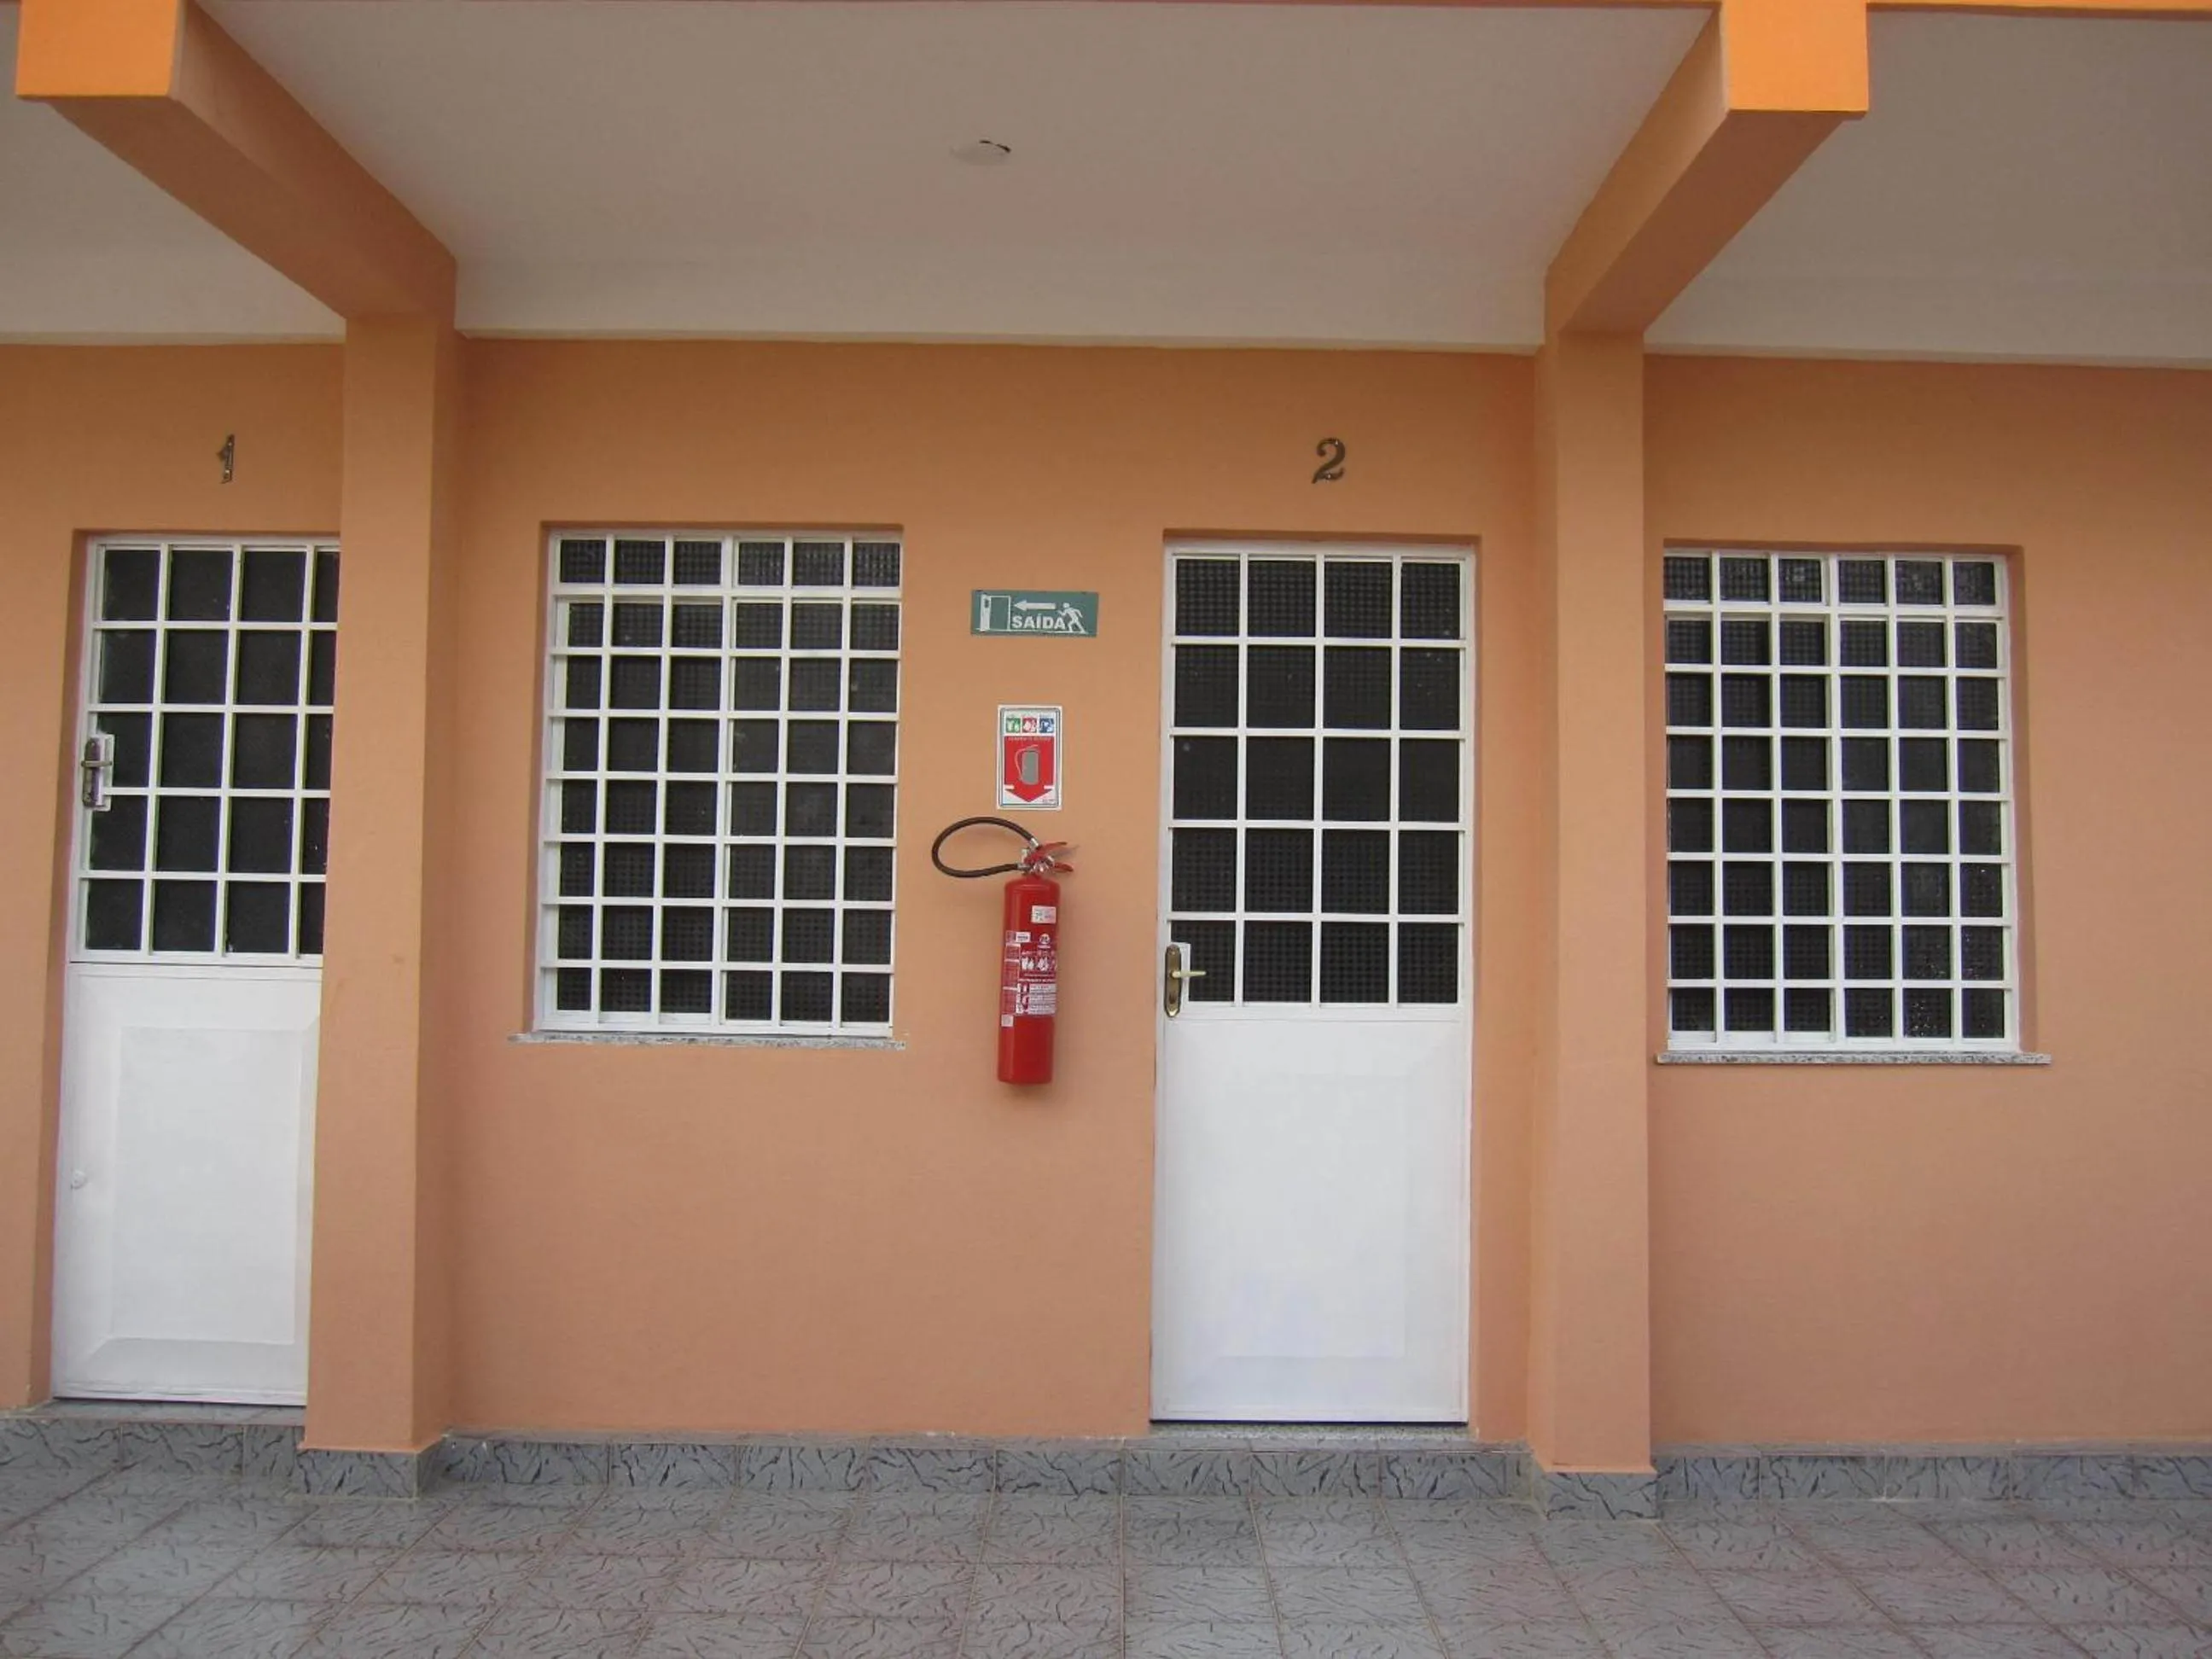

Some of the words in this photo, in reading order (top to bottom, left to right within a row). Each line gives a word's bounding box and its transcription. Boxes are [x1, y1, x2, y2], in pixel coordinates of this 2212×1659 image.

[215, 434, 236, 484] 1
[1311, 437, 1346, 484] 2
[1011, 614, 1066, 630] SAÍDA
